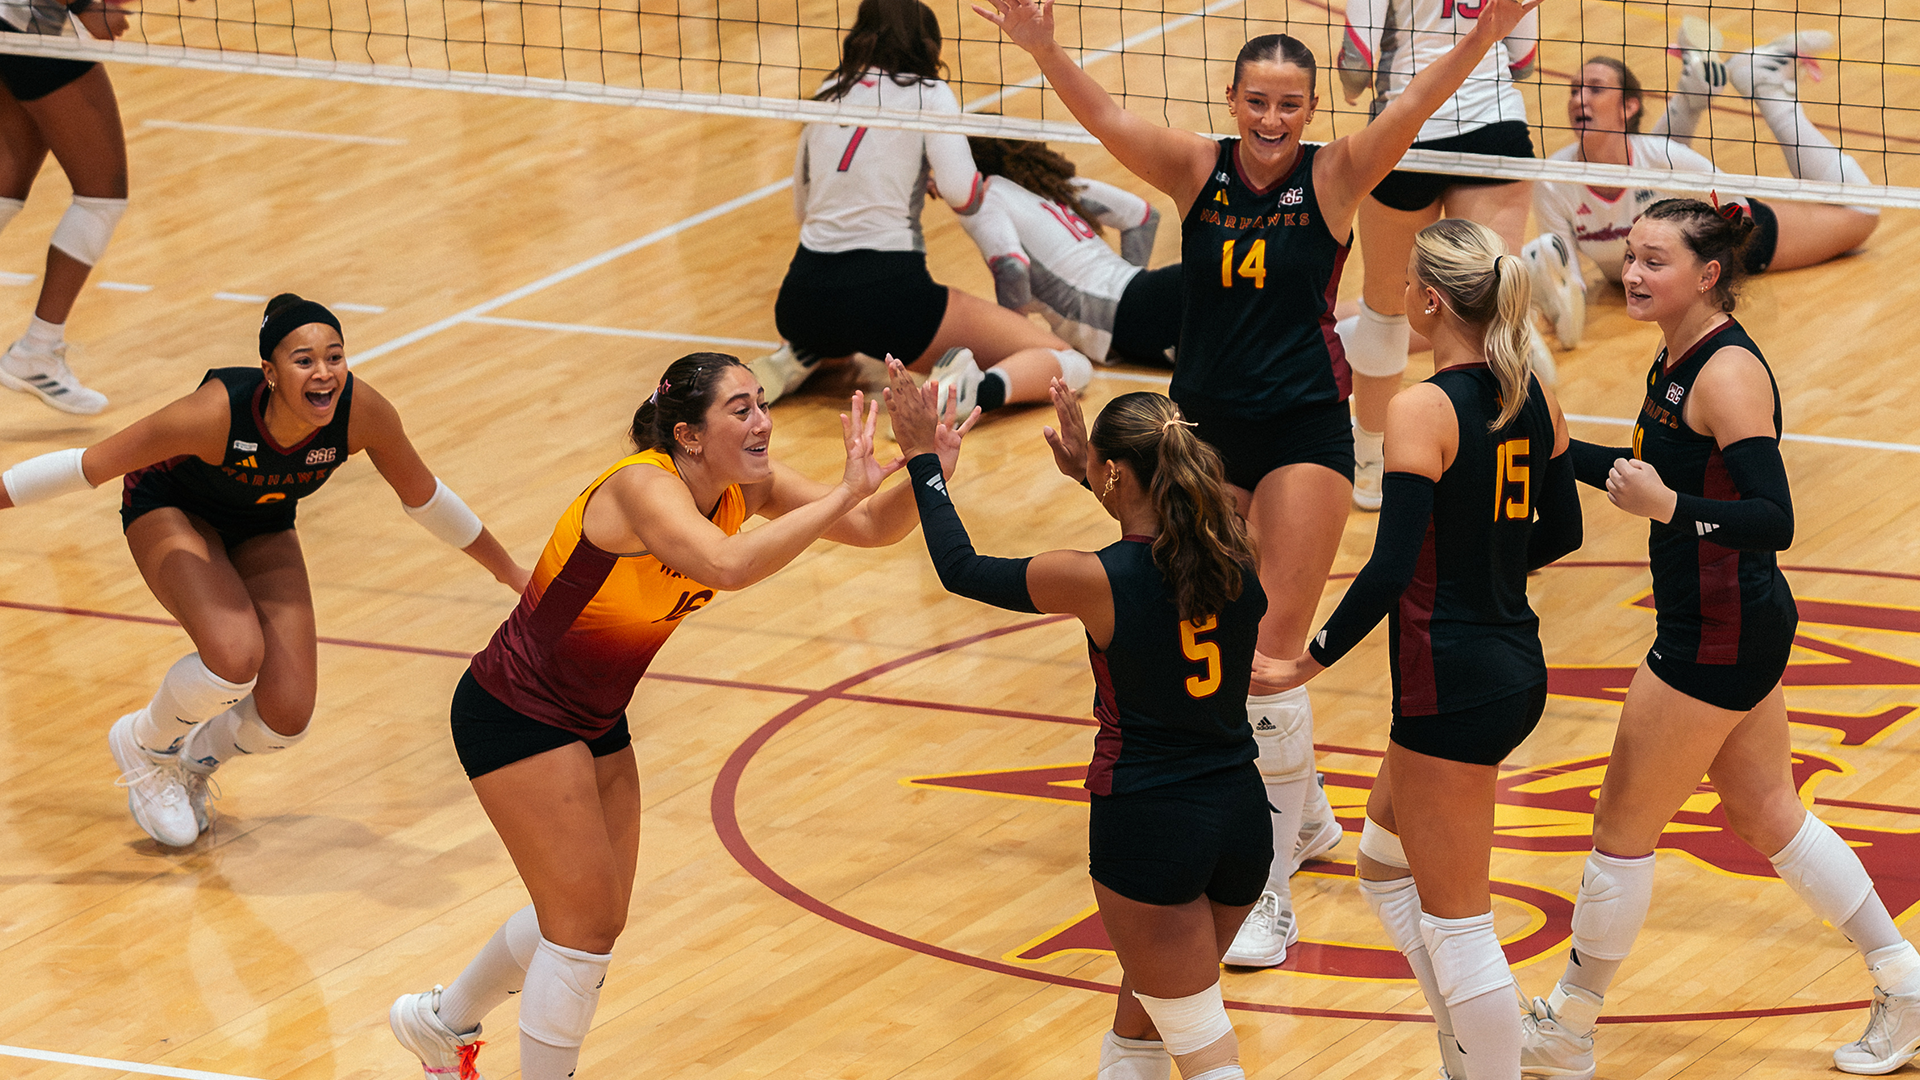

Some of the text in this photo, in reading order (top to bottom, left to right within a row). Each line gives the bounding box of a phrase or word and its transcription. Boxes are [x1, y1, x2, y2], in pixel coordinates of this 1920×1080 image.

[1200, 208, 1310, 230] WARHAWKS
[1221, 238, 1267, 289] 14
[221, 466, 338, 486] WARHAWK
[1494, 436, 1530, 523] 15
[1178, 613, 1223, 700] 5
